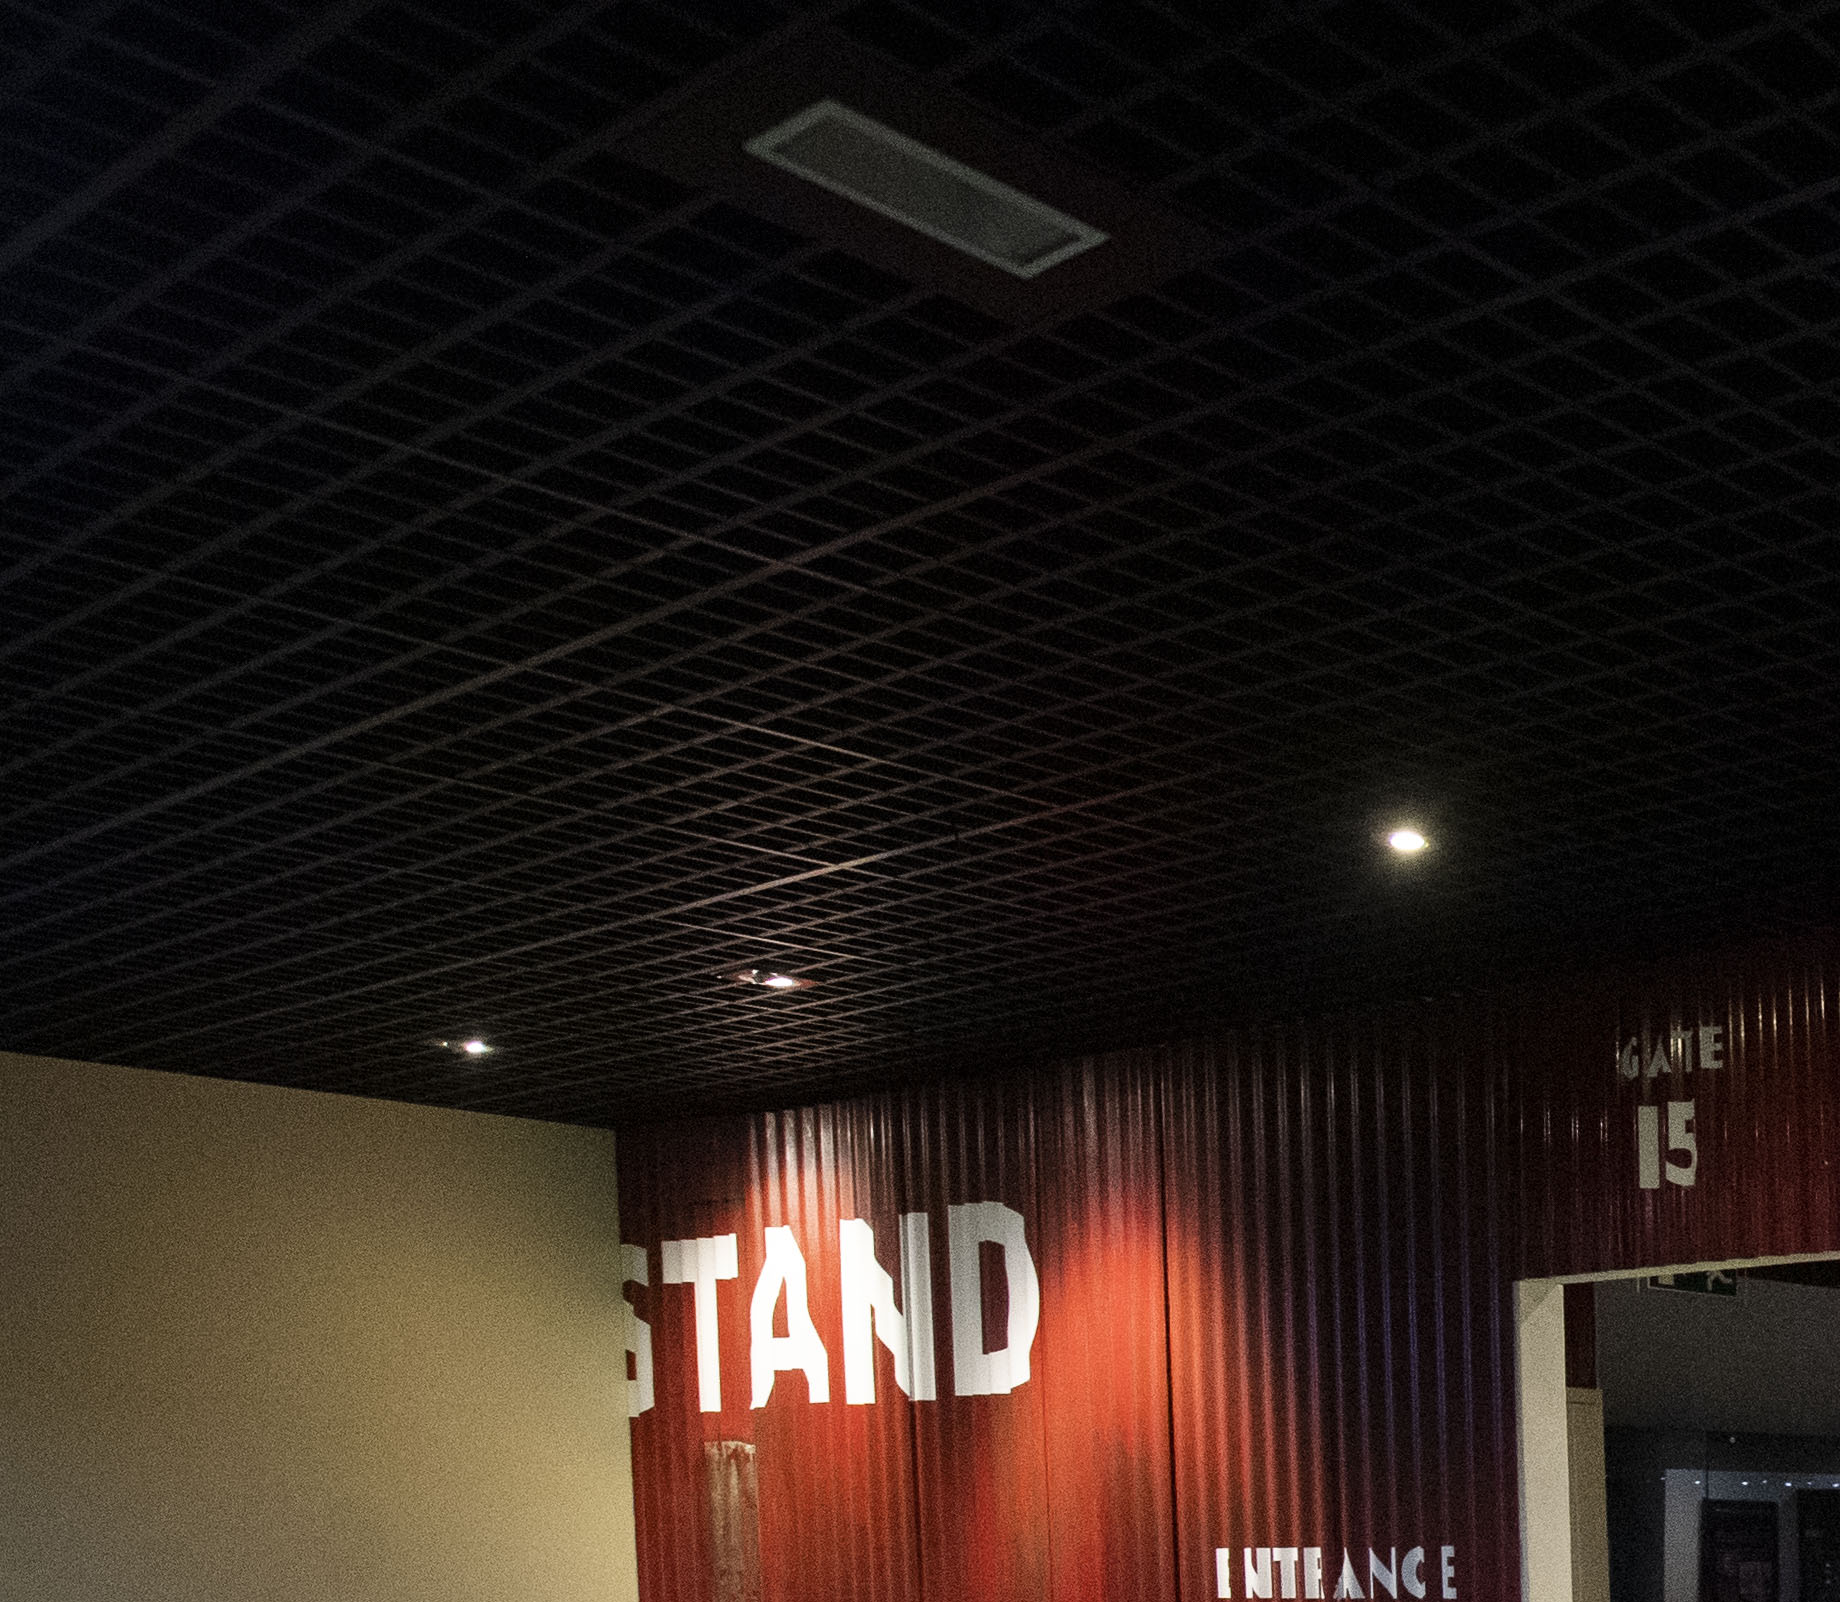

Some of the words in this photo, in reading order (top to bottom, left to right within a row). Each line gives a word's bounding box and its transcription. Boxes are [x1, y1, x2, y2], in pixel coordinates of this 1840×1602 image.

[1619, 1025, 1724, 1080] GATE
[1638, 1098, 1698, 1189] 15
[1216, 1546, 1457, 1600] ENTRANCE
